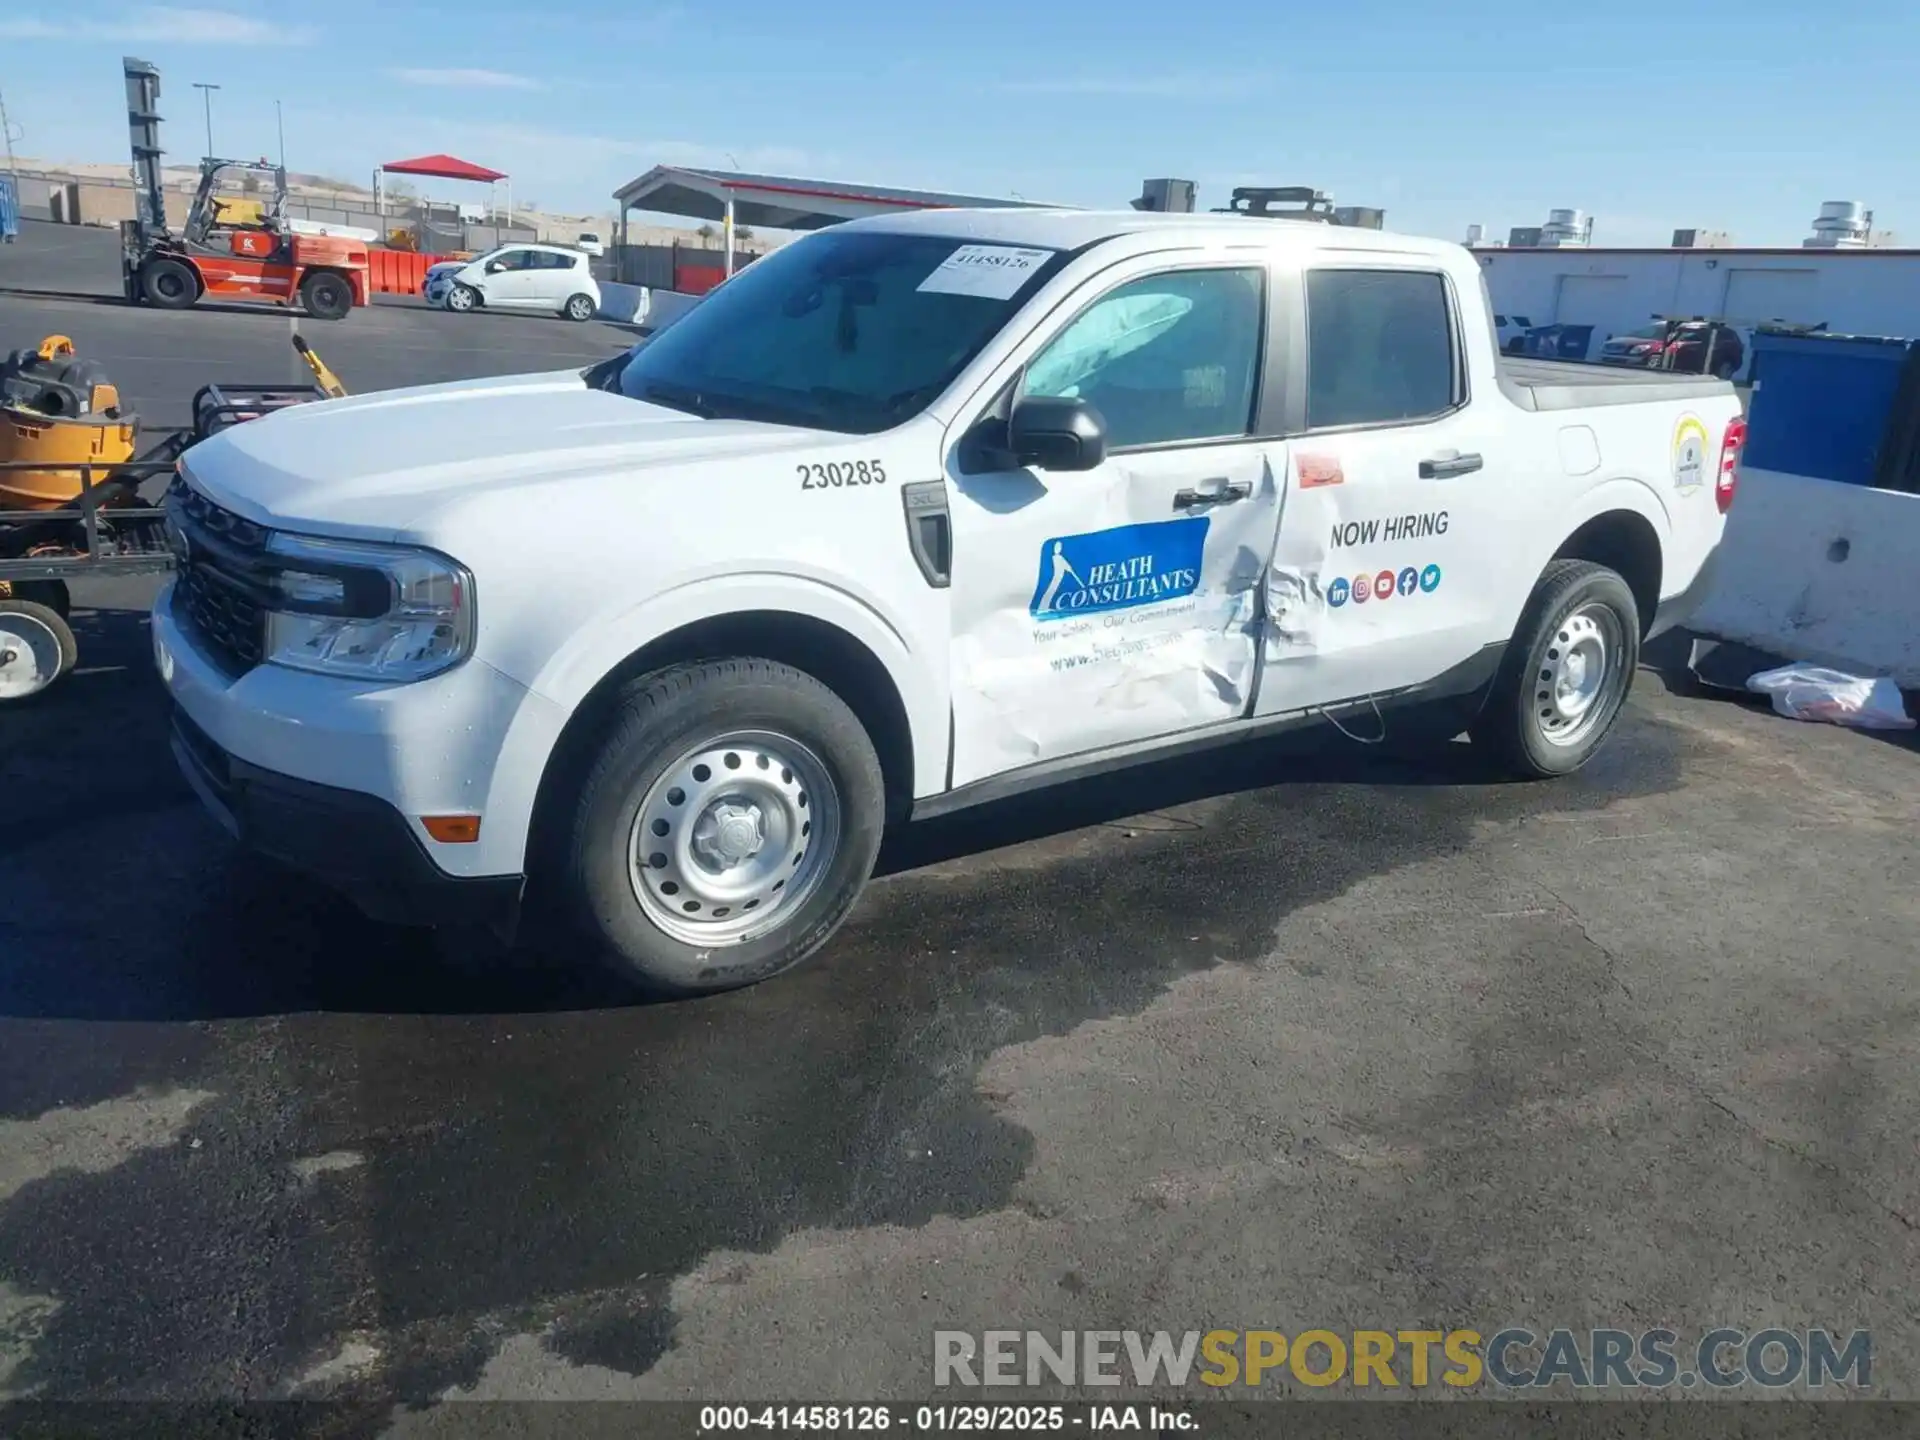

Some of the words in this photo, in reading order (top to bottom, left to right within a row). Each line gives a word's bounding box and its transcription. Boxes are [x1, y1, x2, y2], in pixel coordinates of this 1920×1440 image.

[956, 255, 1029, 268] 41458126
[797, 459, 886, 490] 230285
[1331, 519, 1379, 549] NOW
[1384, 511, 1449, 541] HIRING
[1088, 555, 1153, 586] HEATH
[1055, 568, 1196, 611] CONSULTANTS
[1033, 629, 1057, 645] Your
[1103, 615, 1125, 629] Our
